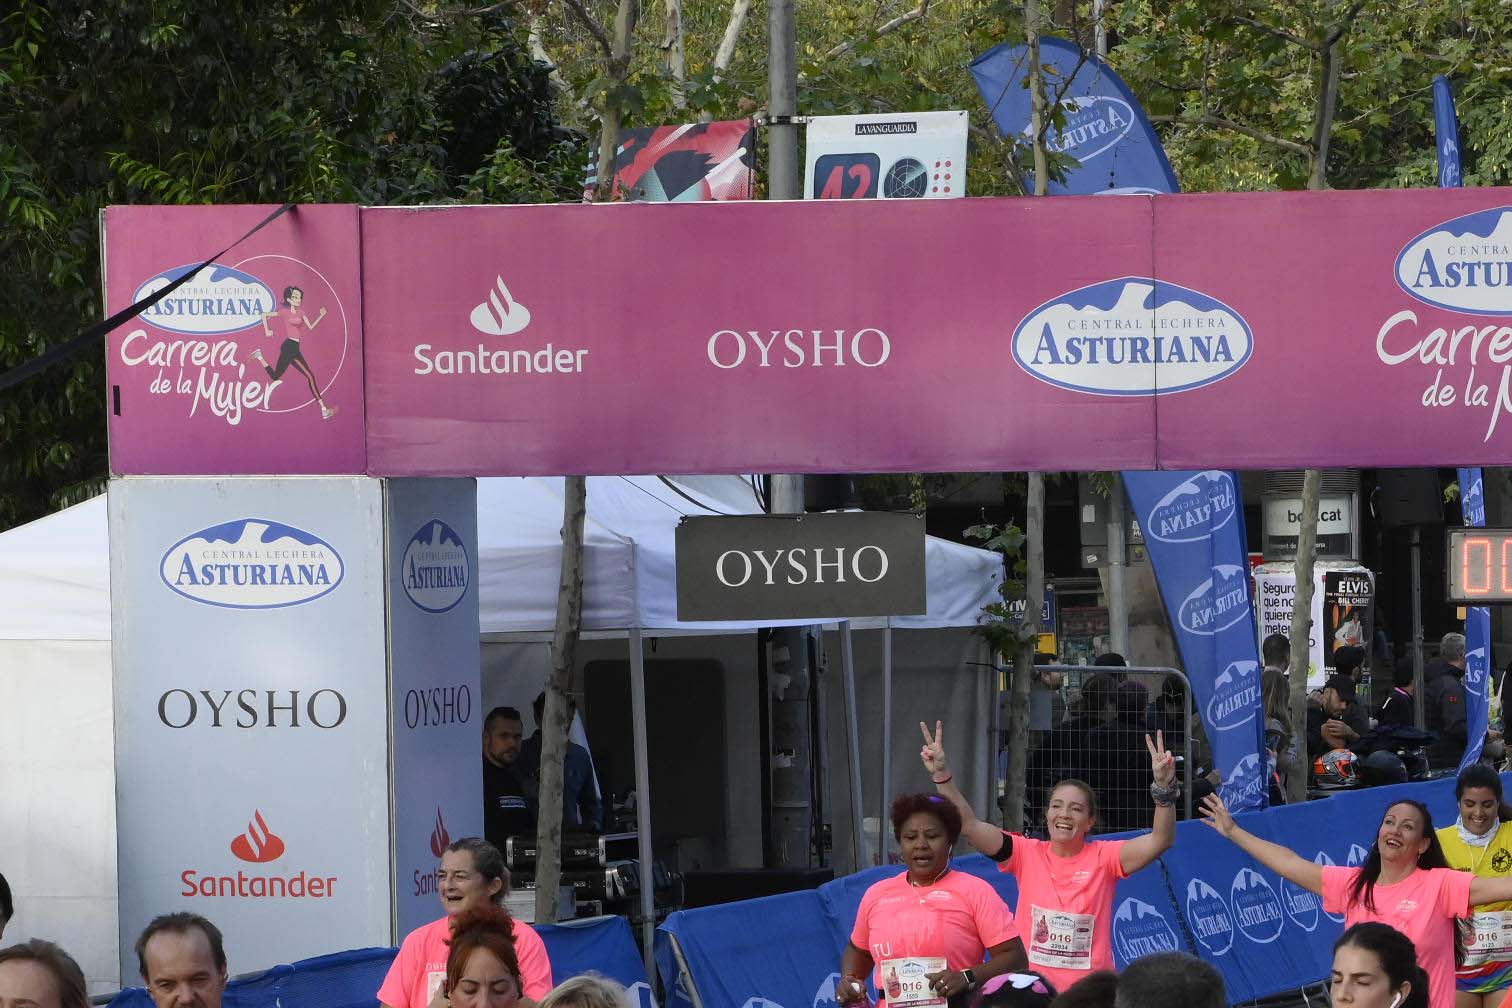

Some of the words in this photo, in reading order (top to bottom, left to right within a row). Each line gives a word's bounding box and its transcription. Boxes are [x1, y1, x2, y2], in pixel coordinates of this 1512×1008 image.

[857, 124, 867, 134] LA
[867, 123, 915, 133] VANGUARDIA
[172, 287, 209, 295] ENTRAL
[1067, 318, 1142, 330] CENTRAL
[121, 330, 239, 368] Carrera
[707, 329, 891, 369] OYSHO
[1031, 322, 1234, 365] ASTURIANA
[414, 344, 588, 374] Santander
[150, 368, 172, 394] de
[177, 368, 192, 394] la
[189, 364, 283, 425] Mujer
[1422, 368, 1456, 407] de
[1464, 367, 1489, 407] la
[202, 550, 260, 560] CENTRAL
[266, 550, 324, 560] LECHERA
[716, 545, 889, 587] OYSHO
[174, 553, 331, 586] ASTURIANA
[408, 563, 465, 592] ASTURIANA
[1338, 580, 1369, 594] ELVIS
[1264, 598, 1281, 608] que
[158, 689, 347, 729] OYSHO
[405, 685, 471, 729] OYSHO
[181, 870, 338, 898] Santander
[873, 942, 891, 957] TU
[1050, 933, 1071, 942] 016
[1478, 932, 1498, 941] 016
[902, 982, 922, 991] 016
